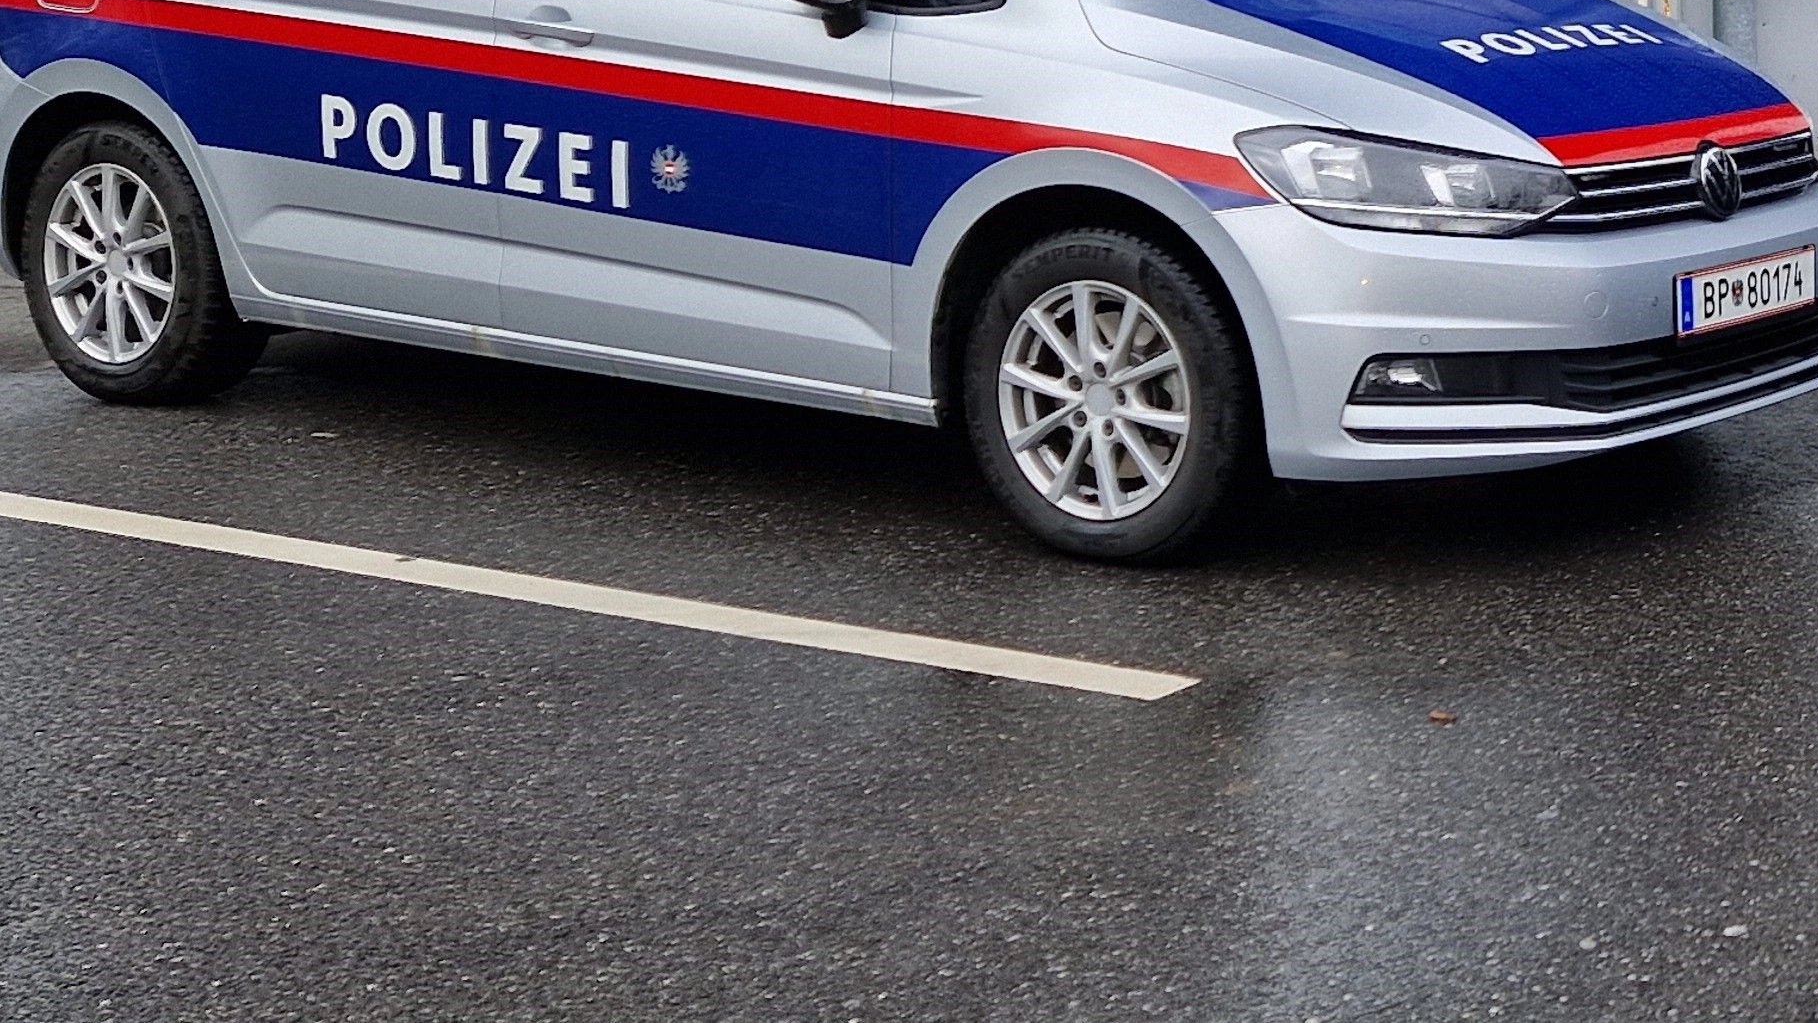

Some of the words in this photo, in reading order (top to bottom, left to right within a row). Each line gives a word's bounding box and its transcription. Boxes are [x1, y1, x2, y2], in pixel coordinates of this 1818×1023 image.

[1440, 24, 1663, 63] POLIZEI
[320, 94, 630, 208] POLIZEI
[1747, 261, 1803, 309] 80174
